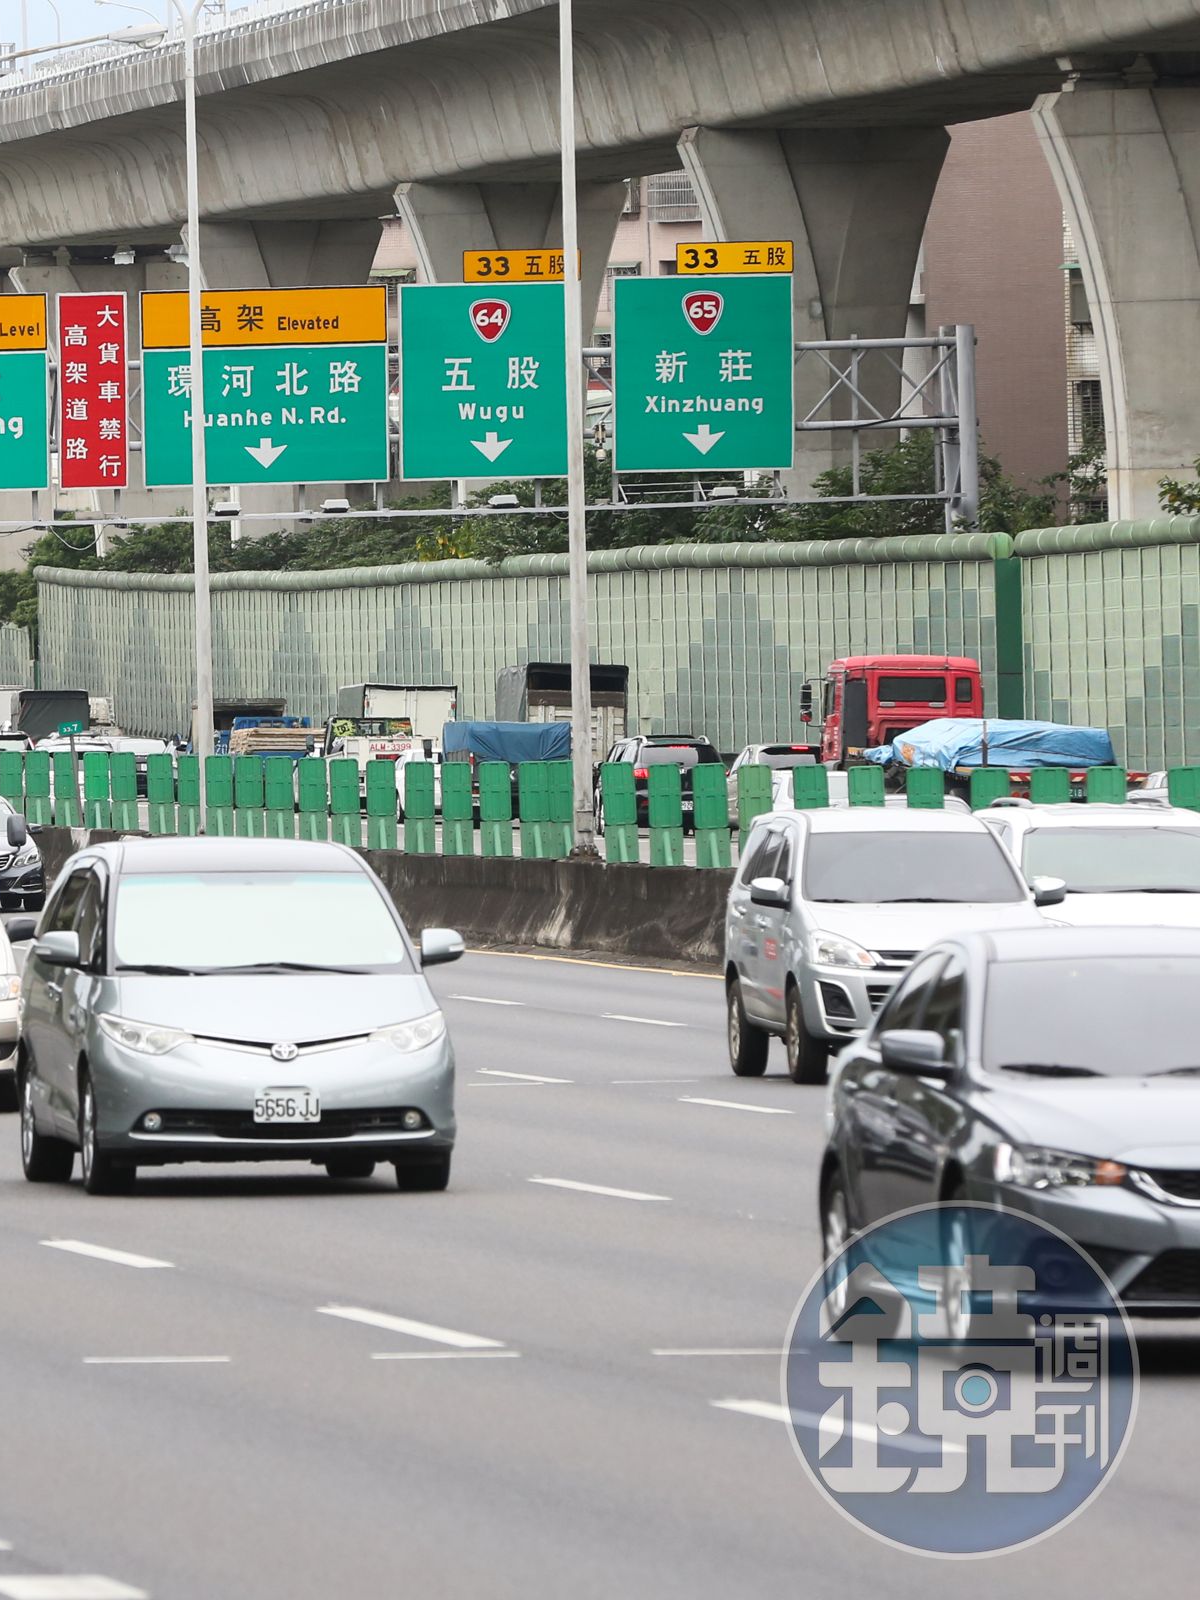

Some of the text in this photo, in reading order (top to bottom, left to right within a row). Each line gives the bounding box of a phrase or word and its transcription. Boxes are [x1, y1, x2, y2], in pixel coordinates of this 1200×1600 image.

[475, 254, 565, 277] 33 五股
[684, 247, 786, 269] 33 五股
[199, 304, 340, 333] 高架 Elevated
[475, 307, 504, 328] 64
[689, 300, 718, 319] 65
[441, 356, 540, 392] 五股
[654, 349, 753, 384] 新莊
[167, 360, 362, 398] 環河北路
[64, 323, 89, 460] 高架道路
[96, 304, 122, 479] 大貨車禁行
[281, 407, 304, 425] N.
[310, 406, 347, 424] Rd.
[458, 402, 525, 423] Wugu
[644, 394, 764, 416] Xinzhuang
